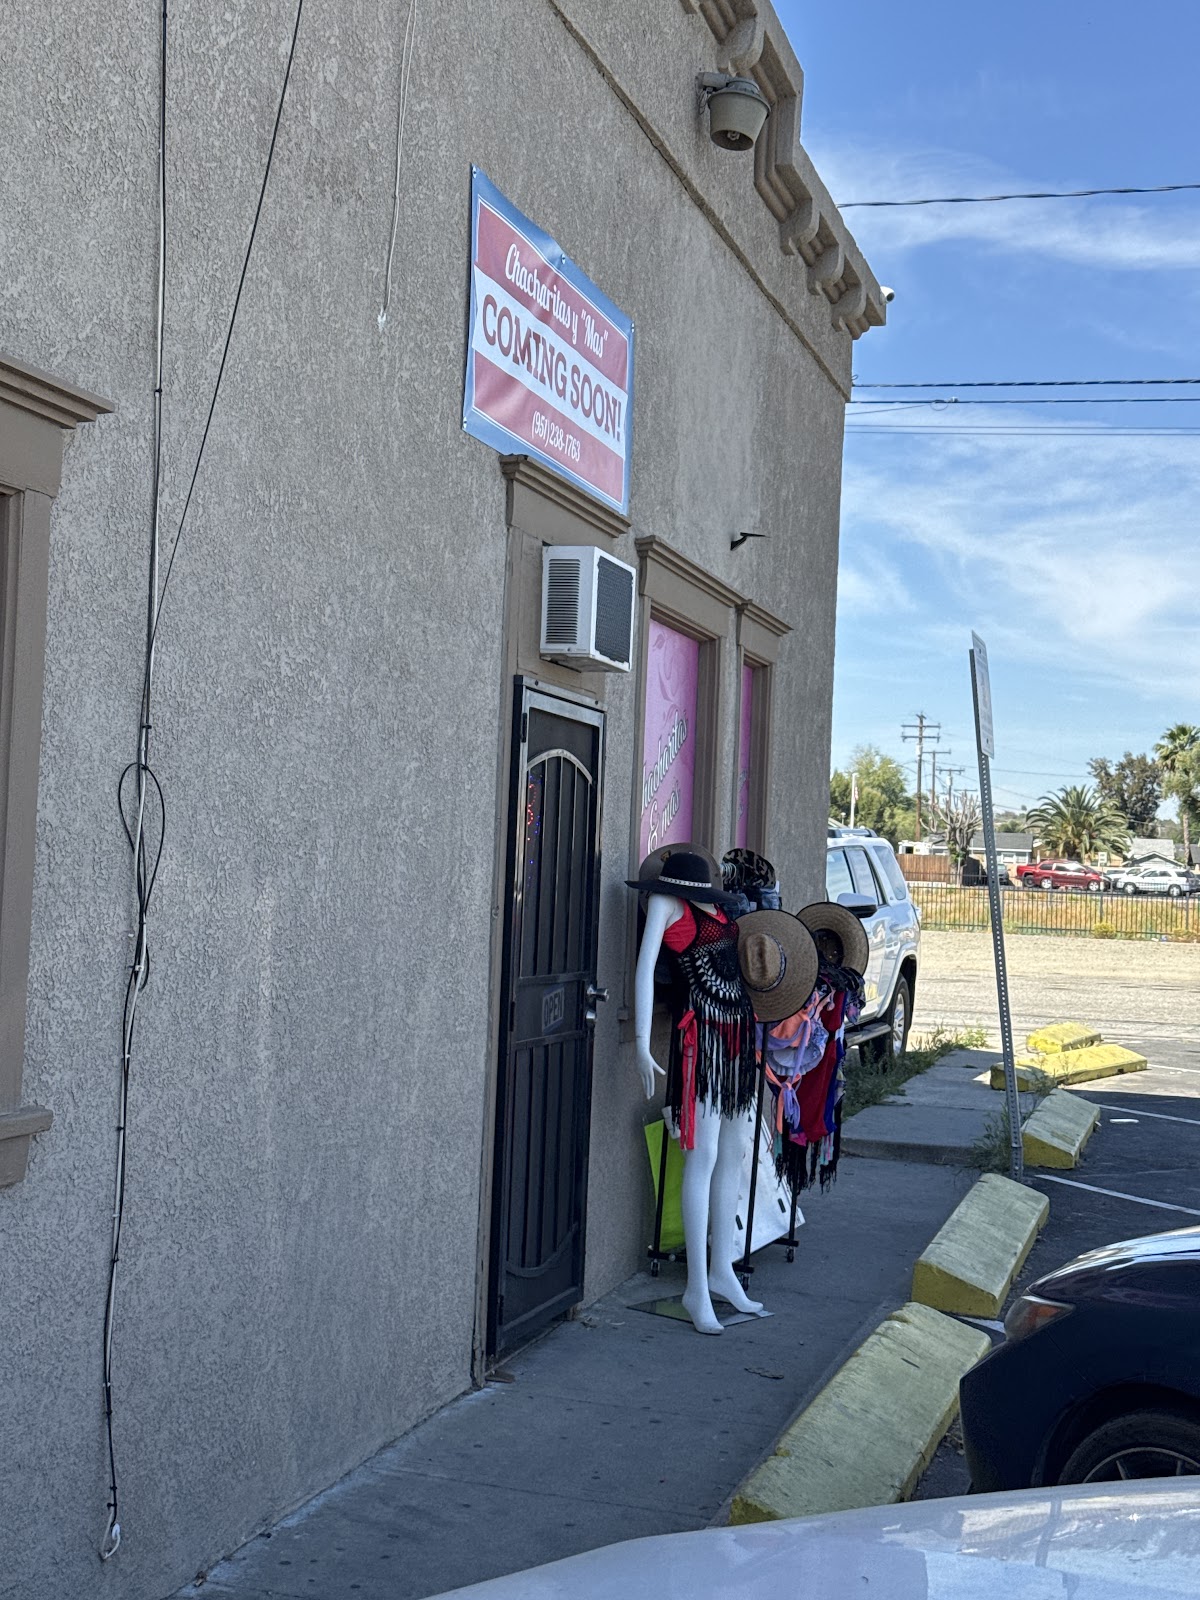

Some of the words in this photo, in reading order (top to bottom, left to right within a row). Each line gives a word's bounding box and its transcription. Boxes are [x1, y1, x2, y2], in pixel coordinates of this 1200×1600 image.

[505, 243, 571, 329] Chacharitas
[571, 310, 579, 345] y
[482, 293, 567, 401] COMING
[570, 364, 622, 442] SOON!
[641, 709, 688, 818] hacharitas
